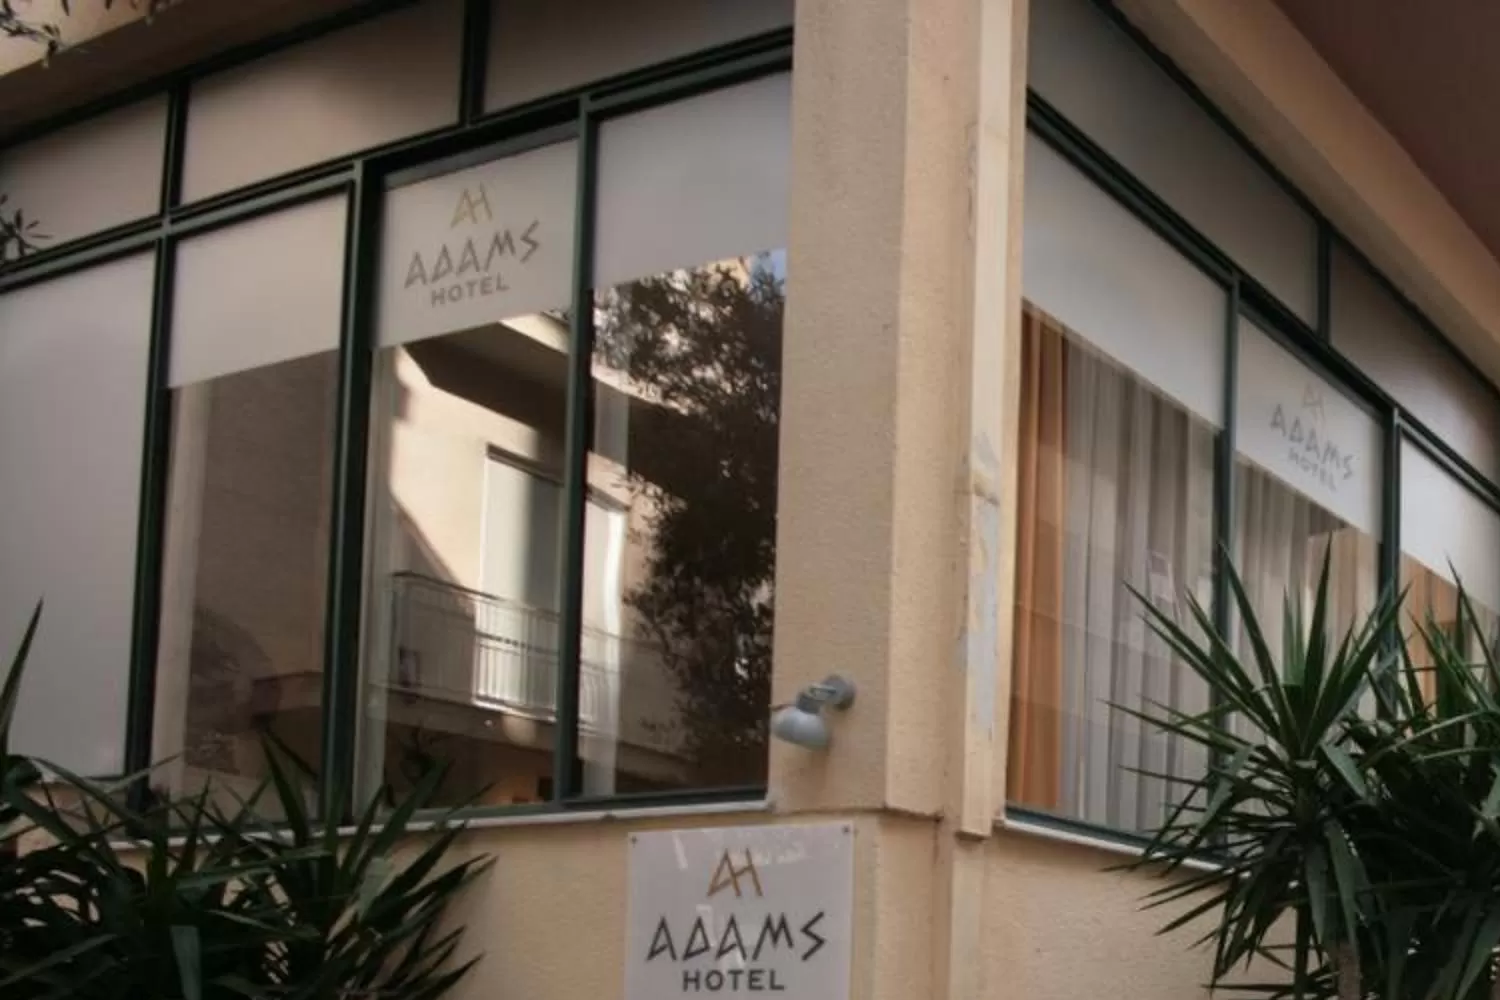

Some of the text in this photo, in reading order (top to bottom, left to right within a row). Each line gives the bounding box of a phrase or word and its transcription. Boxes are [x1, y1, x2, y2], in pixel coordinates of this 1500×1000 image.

[404, 219, 540, 289] ADAMS
[431, 272, 511, 307] HOTEL
[1269, 403, 1354, 480] ADAMS
[647, 911, 826, 962] ADAMS
[682, 969, 785, 991] HOTEL
